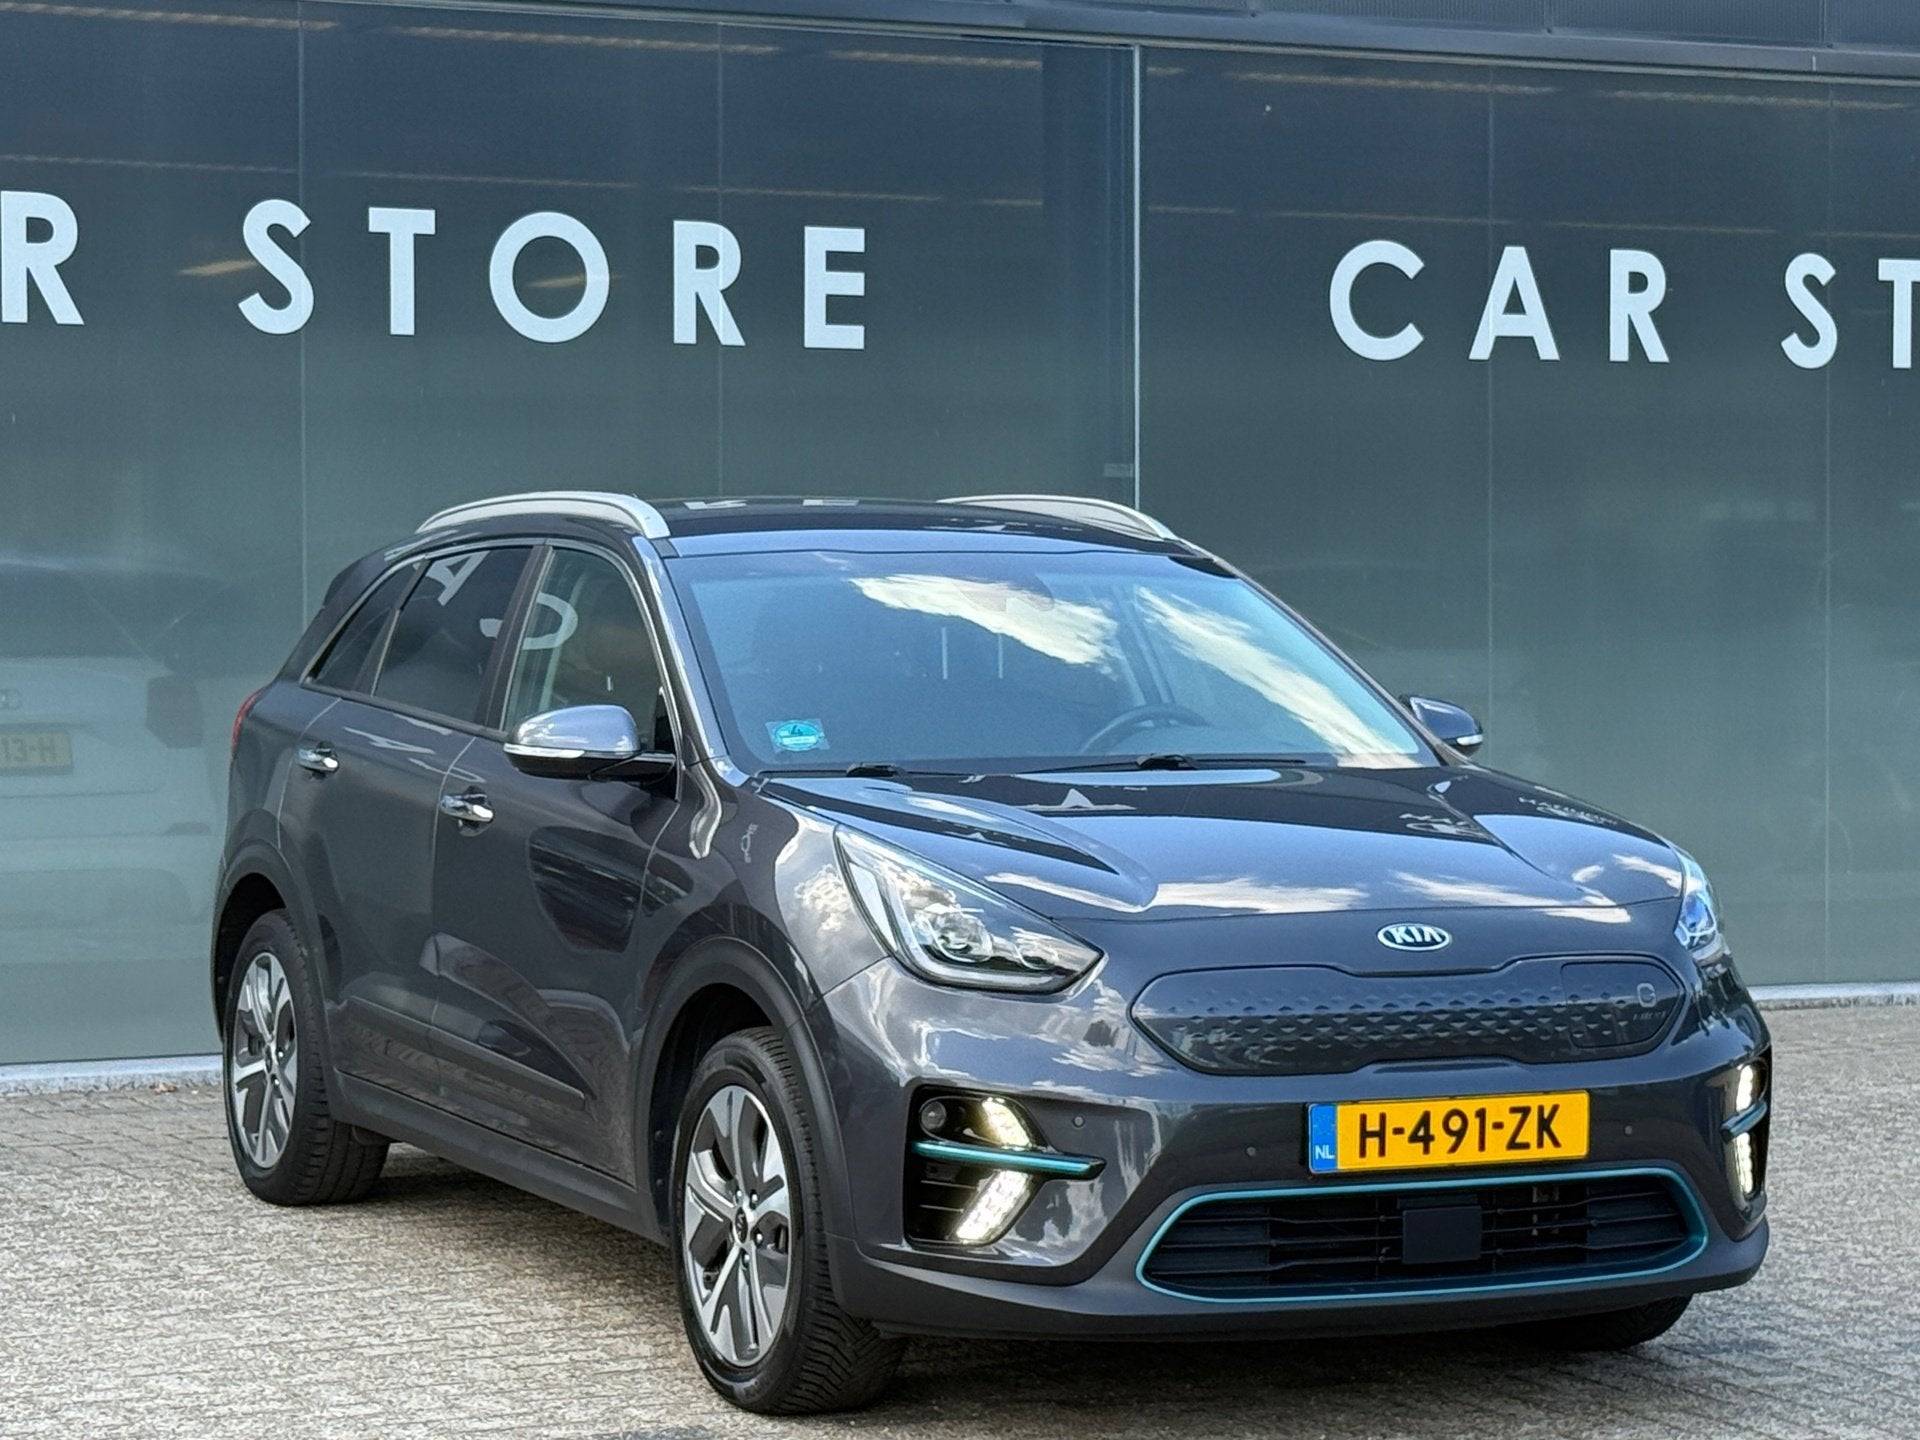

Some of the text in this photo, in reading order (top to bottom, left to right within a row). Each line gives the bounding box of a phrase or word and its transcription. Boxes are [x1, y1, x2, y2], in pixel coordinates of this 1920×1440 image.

[0, 190, 866, 350] R STORE
[1329, 240, 1920, 369] CAR ST
[1386, 925, 1445, 945] KIA
[1314, 1103, 1562, 1160] NL H-491-ZK
